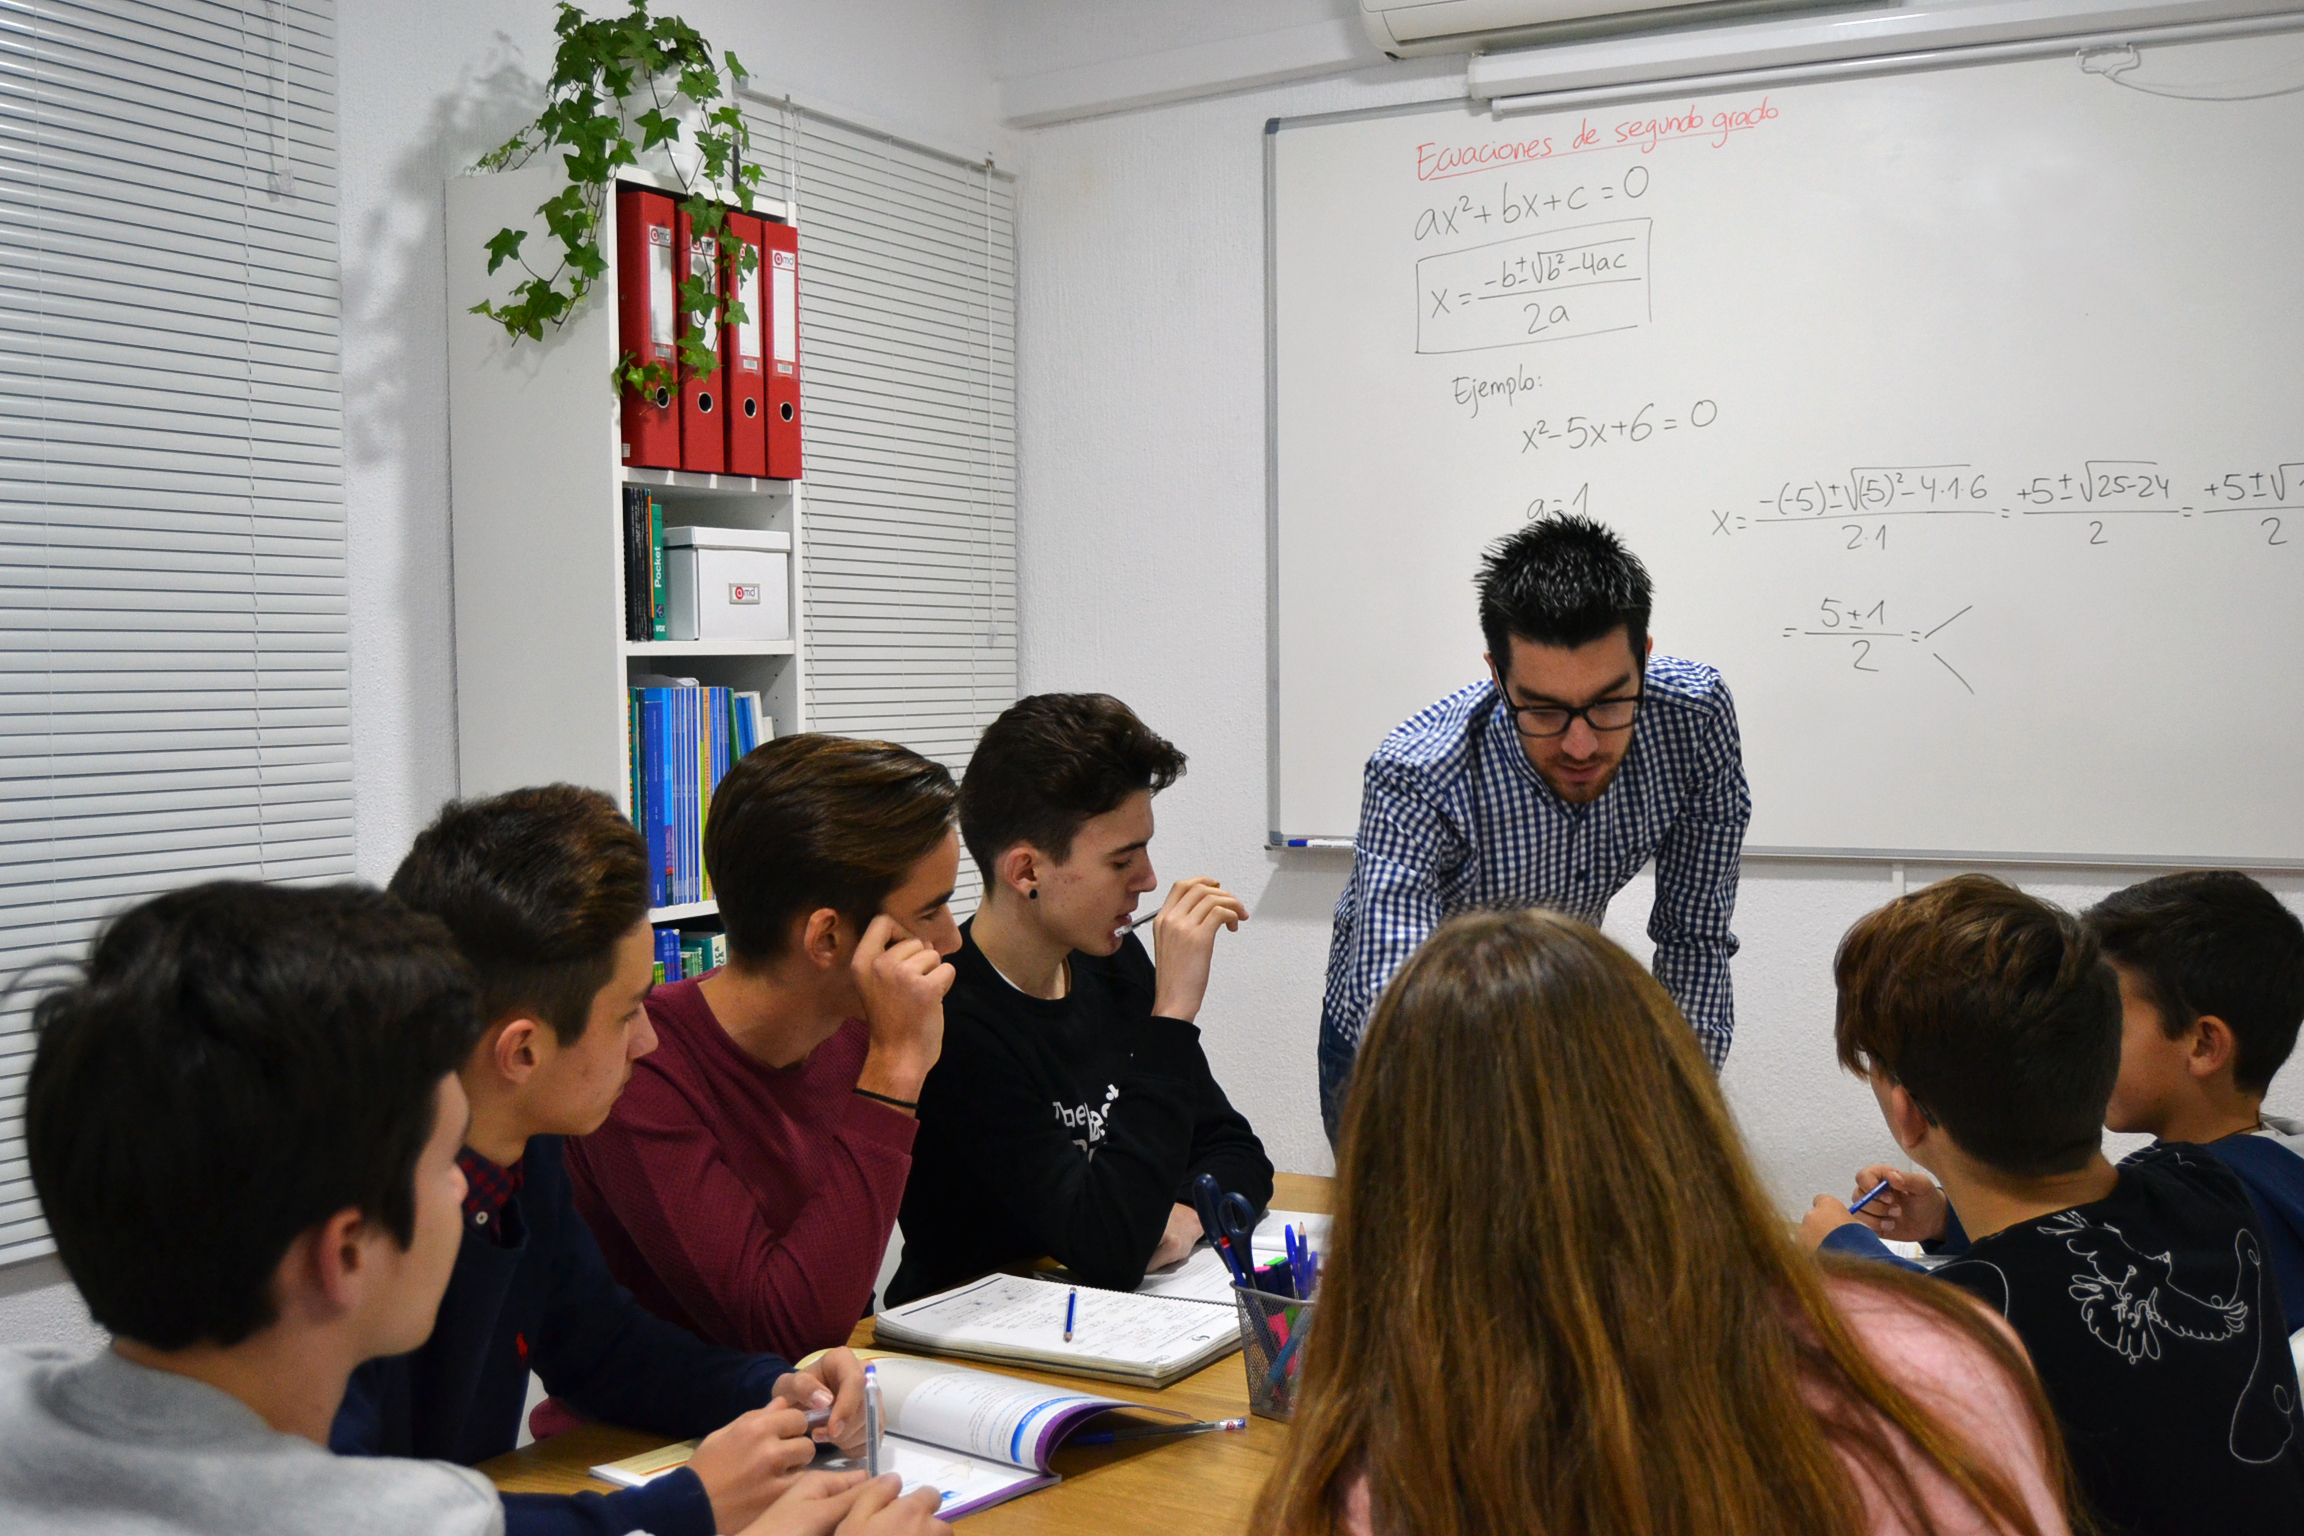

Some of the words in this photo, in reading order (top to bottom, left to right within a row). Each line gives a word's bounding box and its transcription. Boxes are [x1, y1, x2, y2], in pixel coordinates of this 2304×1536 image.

[1416, 135, 1553, 181] Ecuaciones
[1572, 117, 1602, 150] de
[1614, 104, 1704, 154] segundo
[1711, 96, 1780, 149] grado
[1523, 301, 1571, 336] 2a
[1451, 363, 1543, 420] Ejemplo:
[2089, 520, 2110, 546] 2
[2260, 516, 2289, 546] 2
[654, 546, 663, 589] Pocket
[1851, 639, 1880, 673] 2
